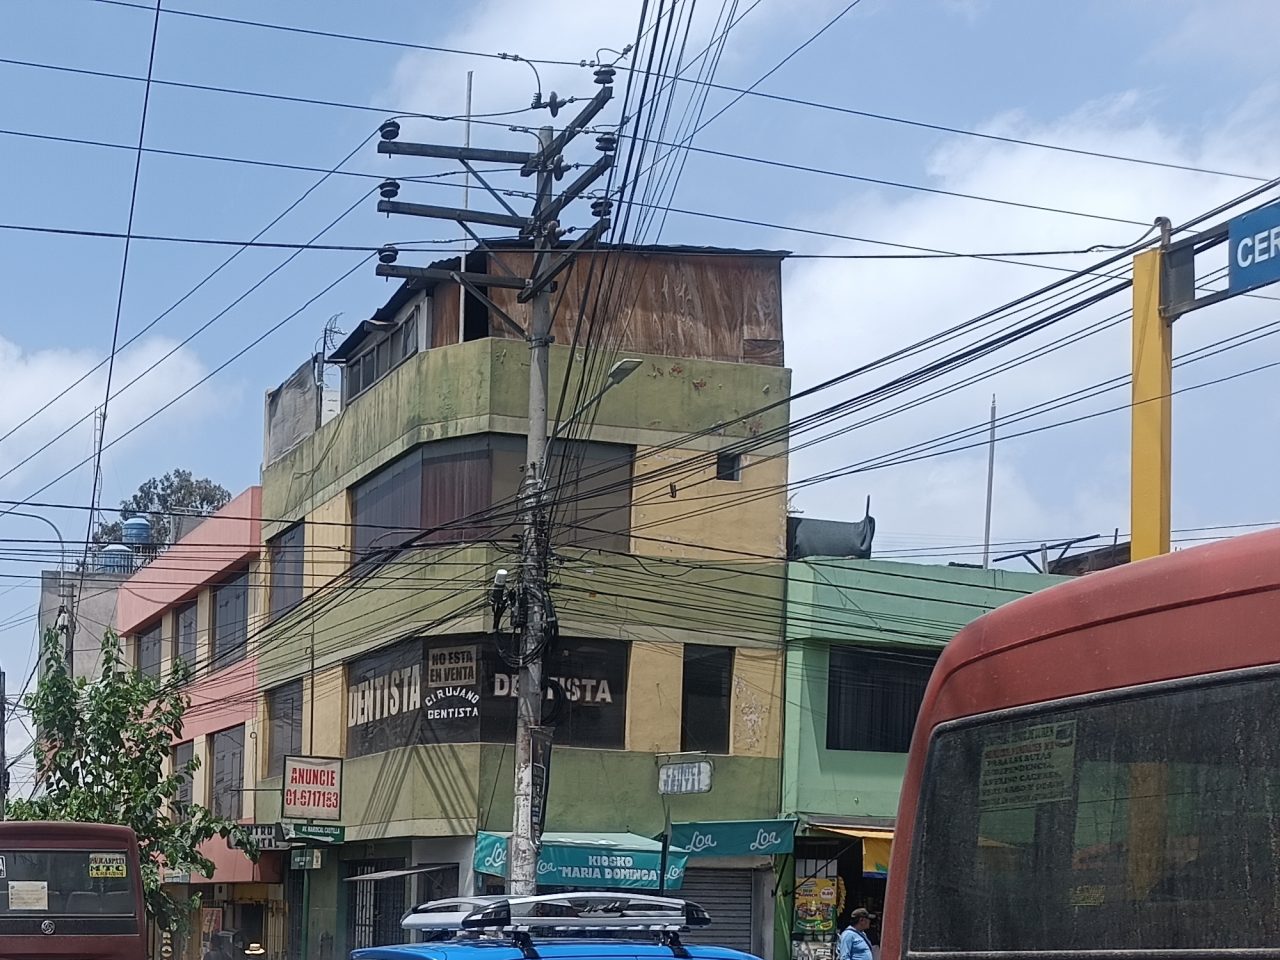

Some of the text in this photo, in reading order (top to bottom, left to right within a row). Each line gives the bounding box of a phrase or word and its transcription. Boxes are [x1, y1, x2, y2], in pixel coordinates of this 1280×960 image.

[431, 650, 473, 666] NO ESTA
[430, 666, 474, 683] EN VENTA
[347, 663, 420, 728] DENTISTA
[424, 687, 480, 707] CIRUJANO
[427, 707, 479, 719] DENTISTA
[290, 767, 336, 787] ANUNCIE
[685, 831, 717, 852] Loa
[750, 829, 781, 850] Loa
[588, 855, 634, 866] KIOSKO
